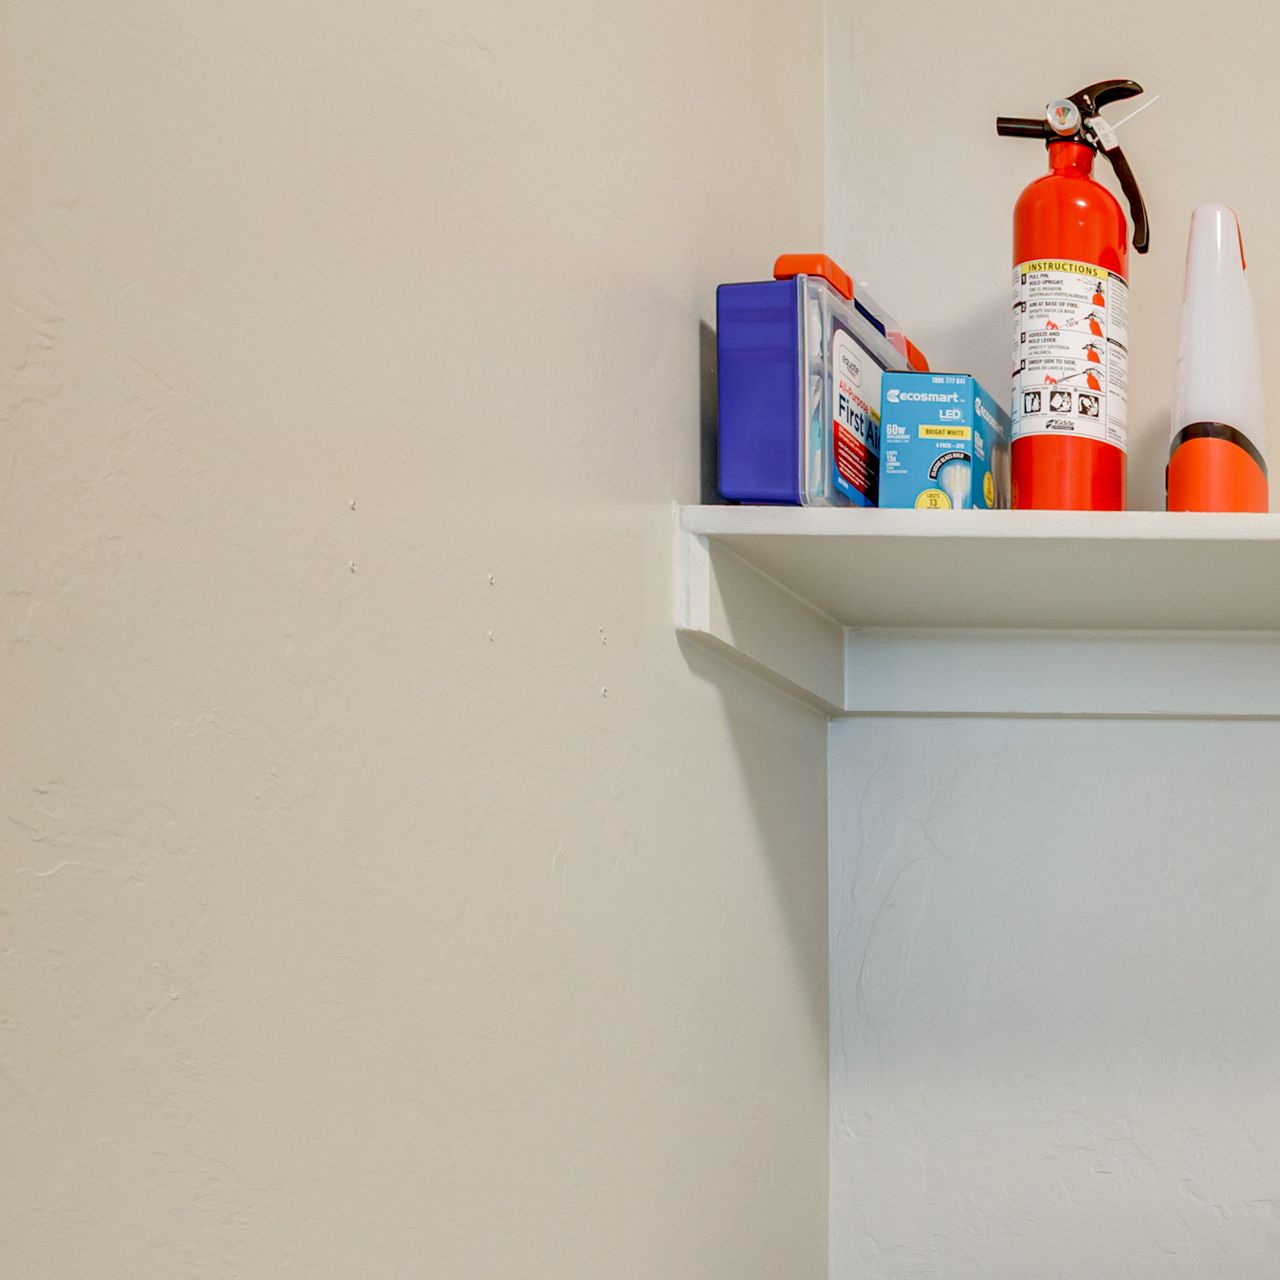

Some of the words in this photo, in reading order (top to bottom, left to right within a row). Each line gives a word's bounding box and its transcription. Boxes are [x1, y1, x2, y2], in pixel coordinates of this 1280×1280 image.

[1028, 262, 1098, 276] INSTRUCTIONS
[839, 380, 868, 414] All-Purpose
[900, 392, 960, 402] ecosmart
[939, 409, 962, 419] LED
[838, 393, 864, 437] First
[866, 421, 880, 450] Ai
[925, 428, 946, 436] BRIGHT
[930, 498, 938, 507] 13
